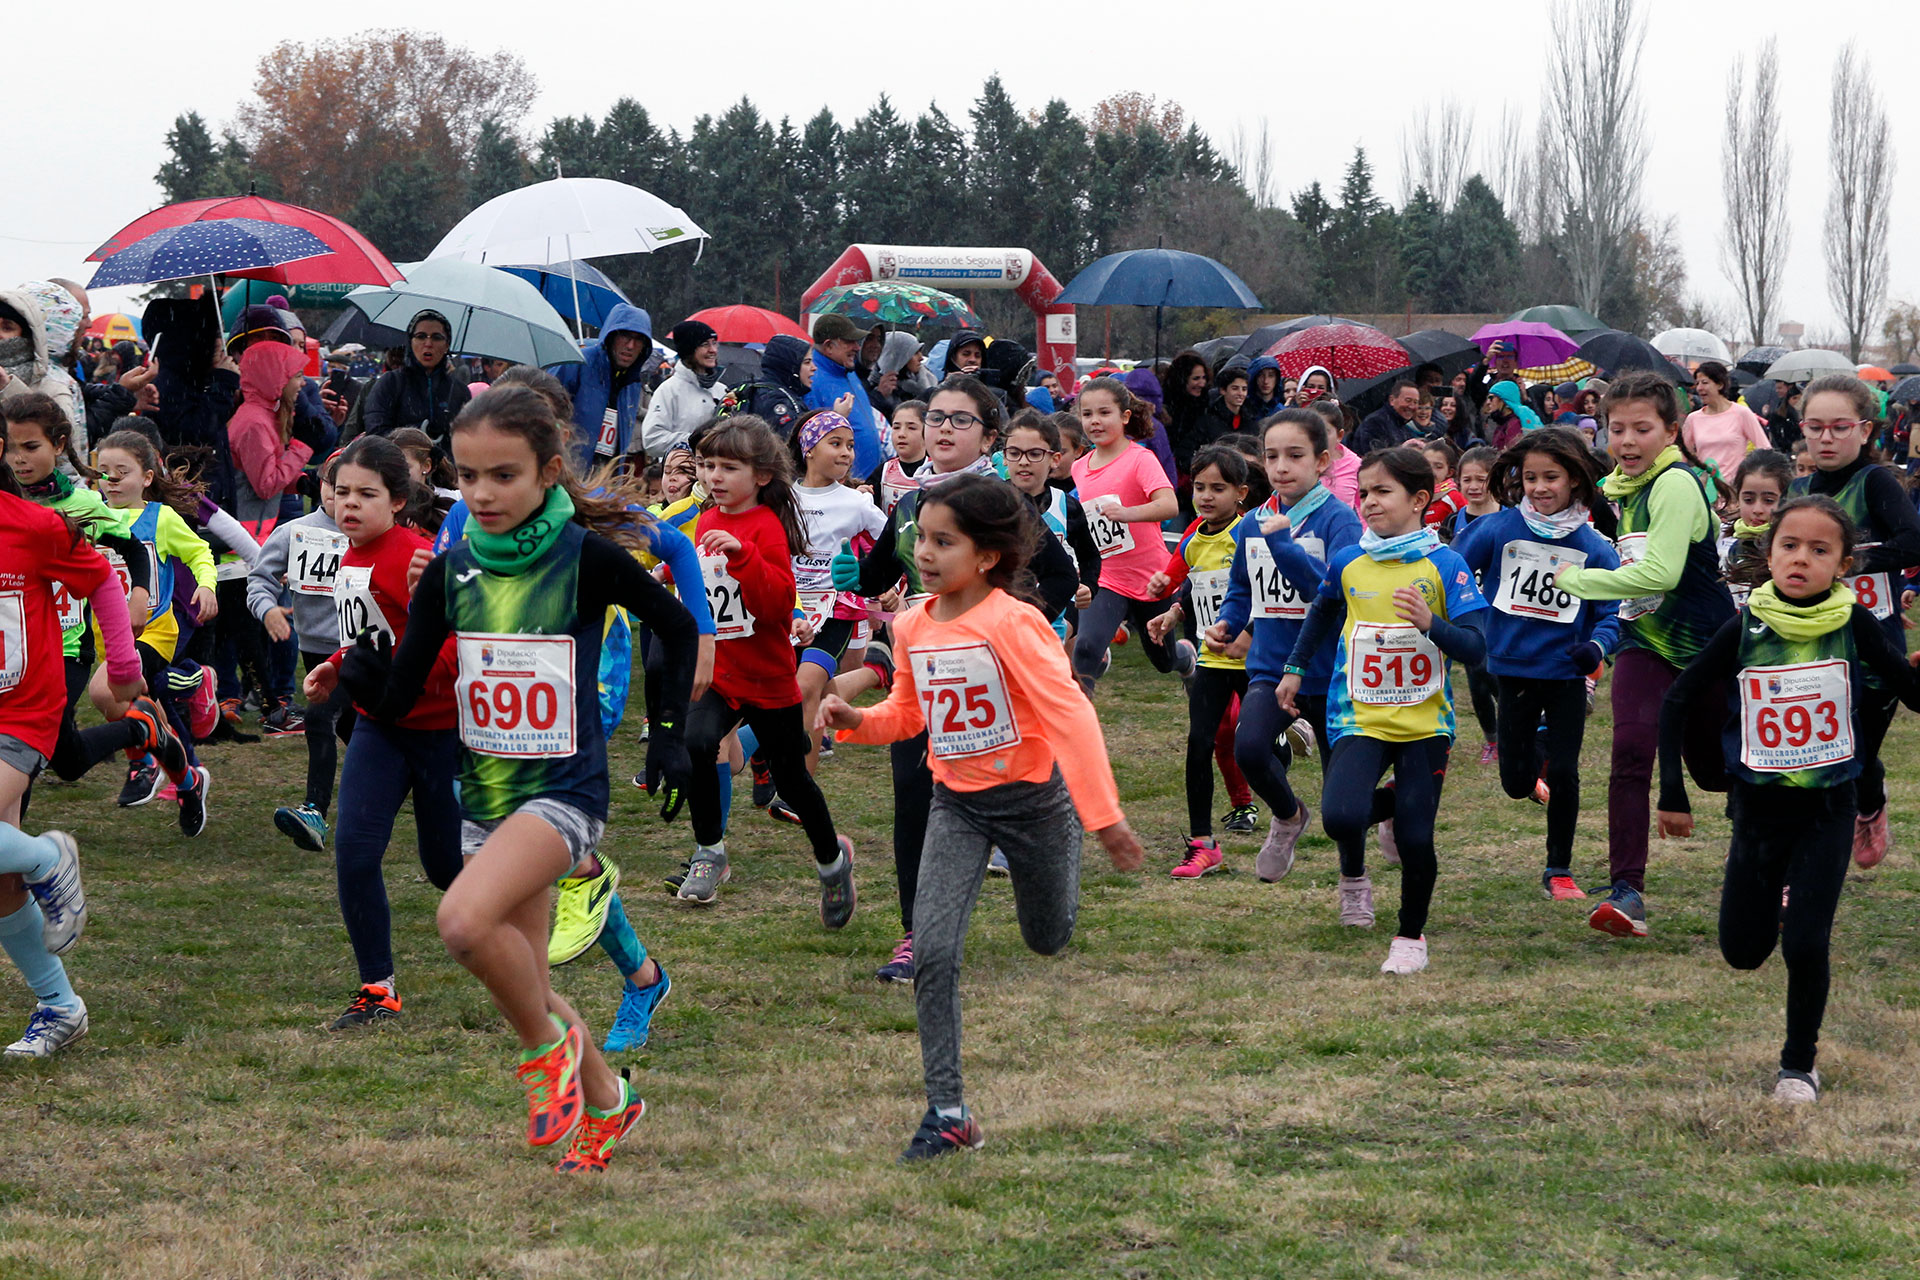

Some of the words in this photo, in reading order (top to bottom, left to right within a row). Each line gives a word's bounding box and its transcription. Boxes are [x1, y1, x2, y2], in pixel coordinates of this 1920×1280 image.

[897, 255, 950, 267] Diputación
[951, 254, 964, 265] de
[965, 255, 1003, 268] Segovia
[899, 269, 930, 277] Asuntos
[931, 269, 961, 277] Sociales
[962, 270, 967, 278] y
[968, 270, 1001, 278] Deportes
[1090, 519, 1125, 548] 134
[496, 648, 537, 660] Diputación
[496, 658, 506, 666] de
[507, 658, 537, 669] Segovia
[938, 658, 965, 667] Diputación
[946, 666, 967, 675] Segovia
[1361, 653, 1433, 689] 519
[1783, 675, 1821, 686] Diputación
[1795, 683, 1822, 693] Segovia
[468, 680, 558, 731] 690
[921, 683, 997, 735] 725
[1756, 700, 1840, 749] 693
[508, 731, 556, 741] NACIONAL
[557, 731, 569, 740] DE
[957, 728, 999, 741] NACIONAL
[1000, 723, 1012, 732] DE
[470, 739, 529, 752] CANTIMPALOS
[1750, 749, 1774, 758] XLVIII
[1775, 749, 1800, 757] CROSS
[1801, 742, 1841, 755] NACIONAL
[1757, 755, 1819, 767] CANTIMPALOS
